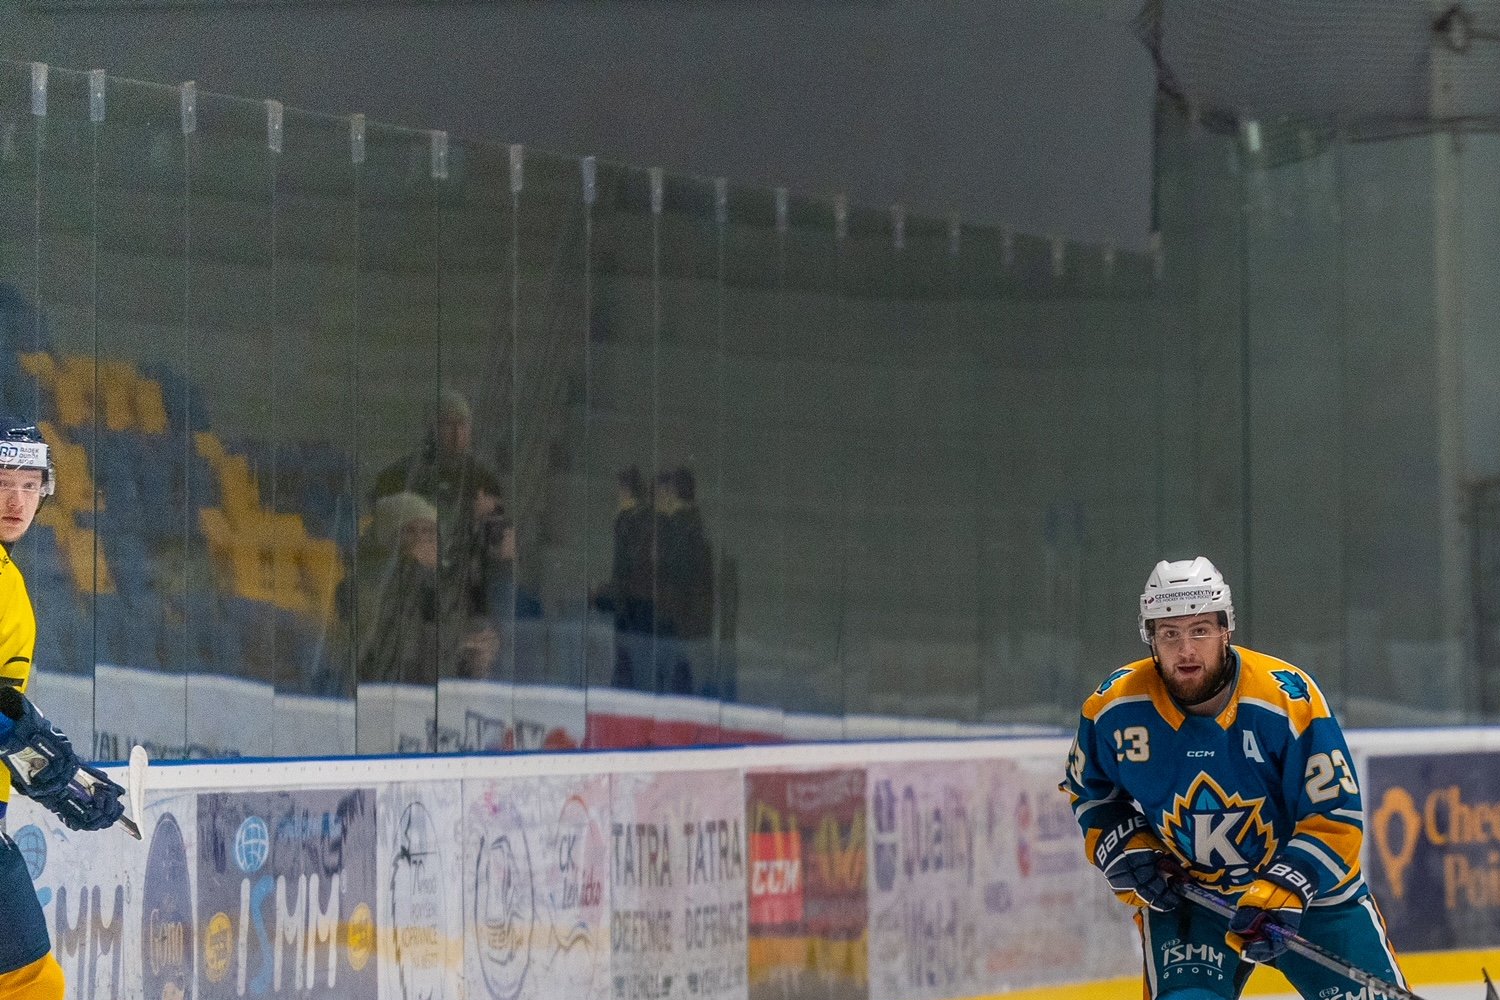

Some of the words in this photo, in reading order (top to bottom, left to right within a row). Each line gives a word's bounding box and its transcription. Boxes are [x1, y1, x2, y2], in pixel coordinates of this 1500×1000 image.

[1155, 590, 1211, 600] CZECHICEHOCKEY.TV
[1186, 750, 1215, 758] CCM
[1243, 730, 1265, 762] A
[1305, 750, 1358, 803] 23
[611, 822, 673, 888] TATRA
[683, 818, 744, 884] TATRA
[1096, 815, 1148, 866] BAUE
[1192, 811, 1250, 866] K
[752, 858, 798, 896] CCM
[237, 873, 340, 996] ISMM
[1163, 943, 1223, 968] ISMM
[1163, 967, 1223, 980] GROUP
